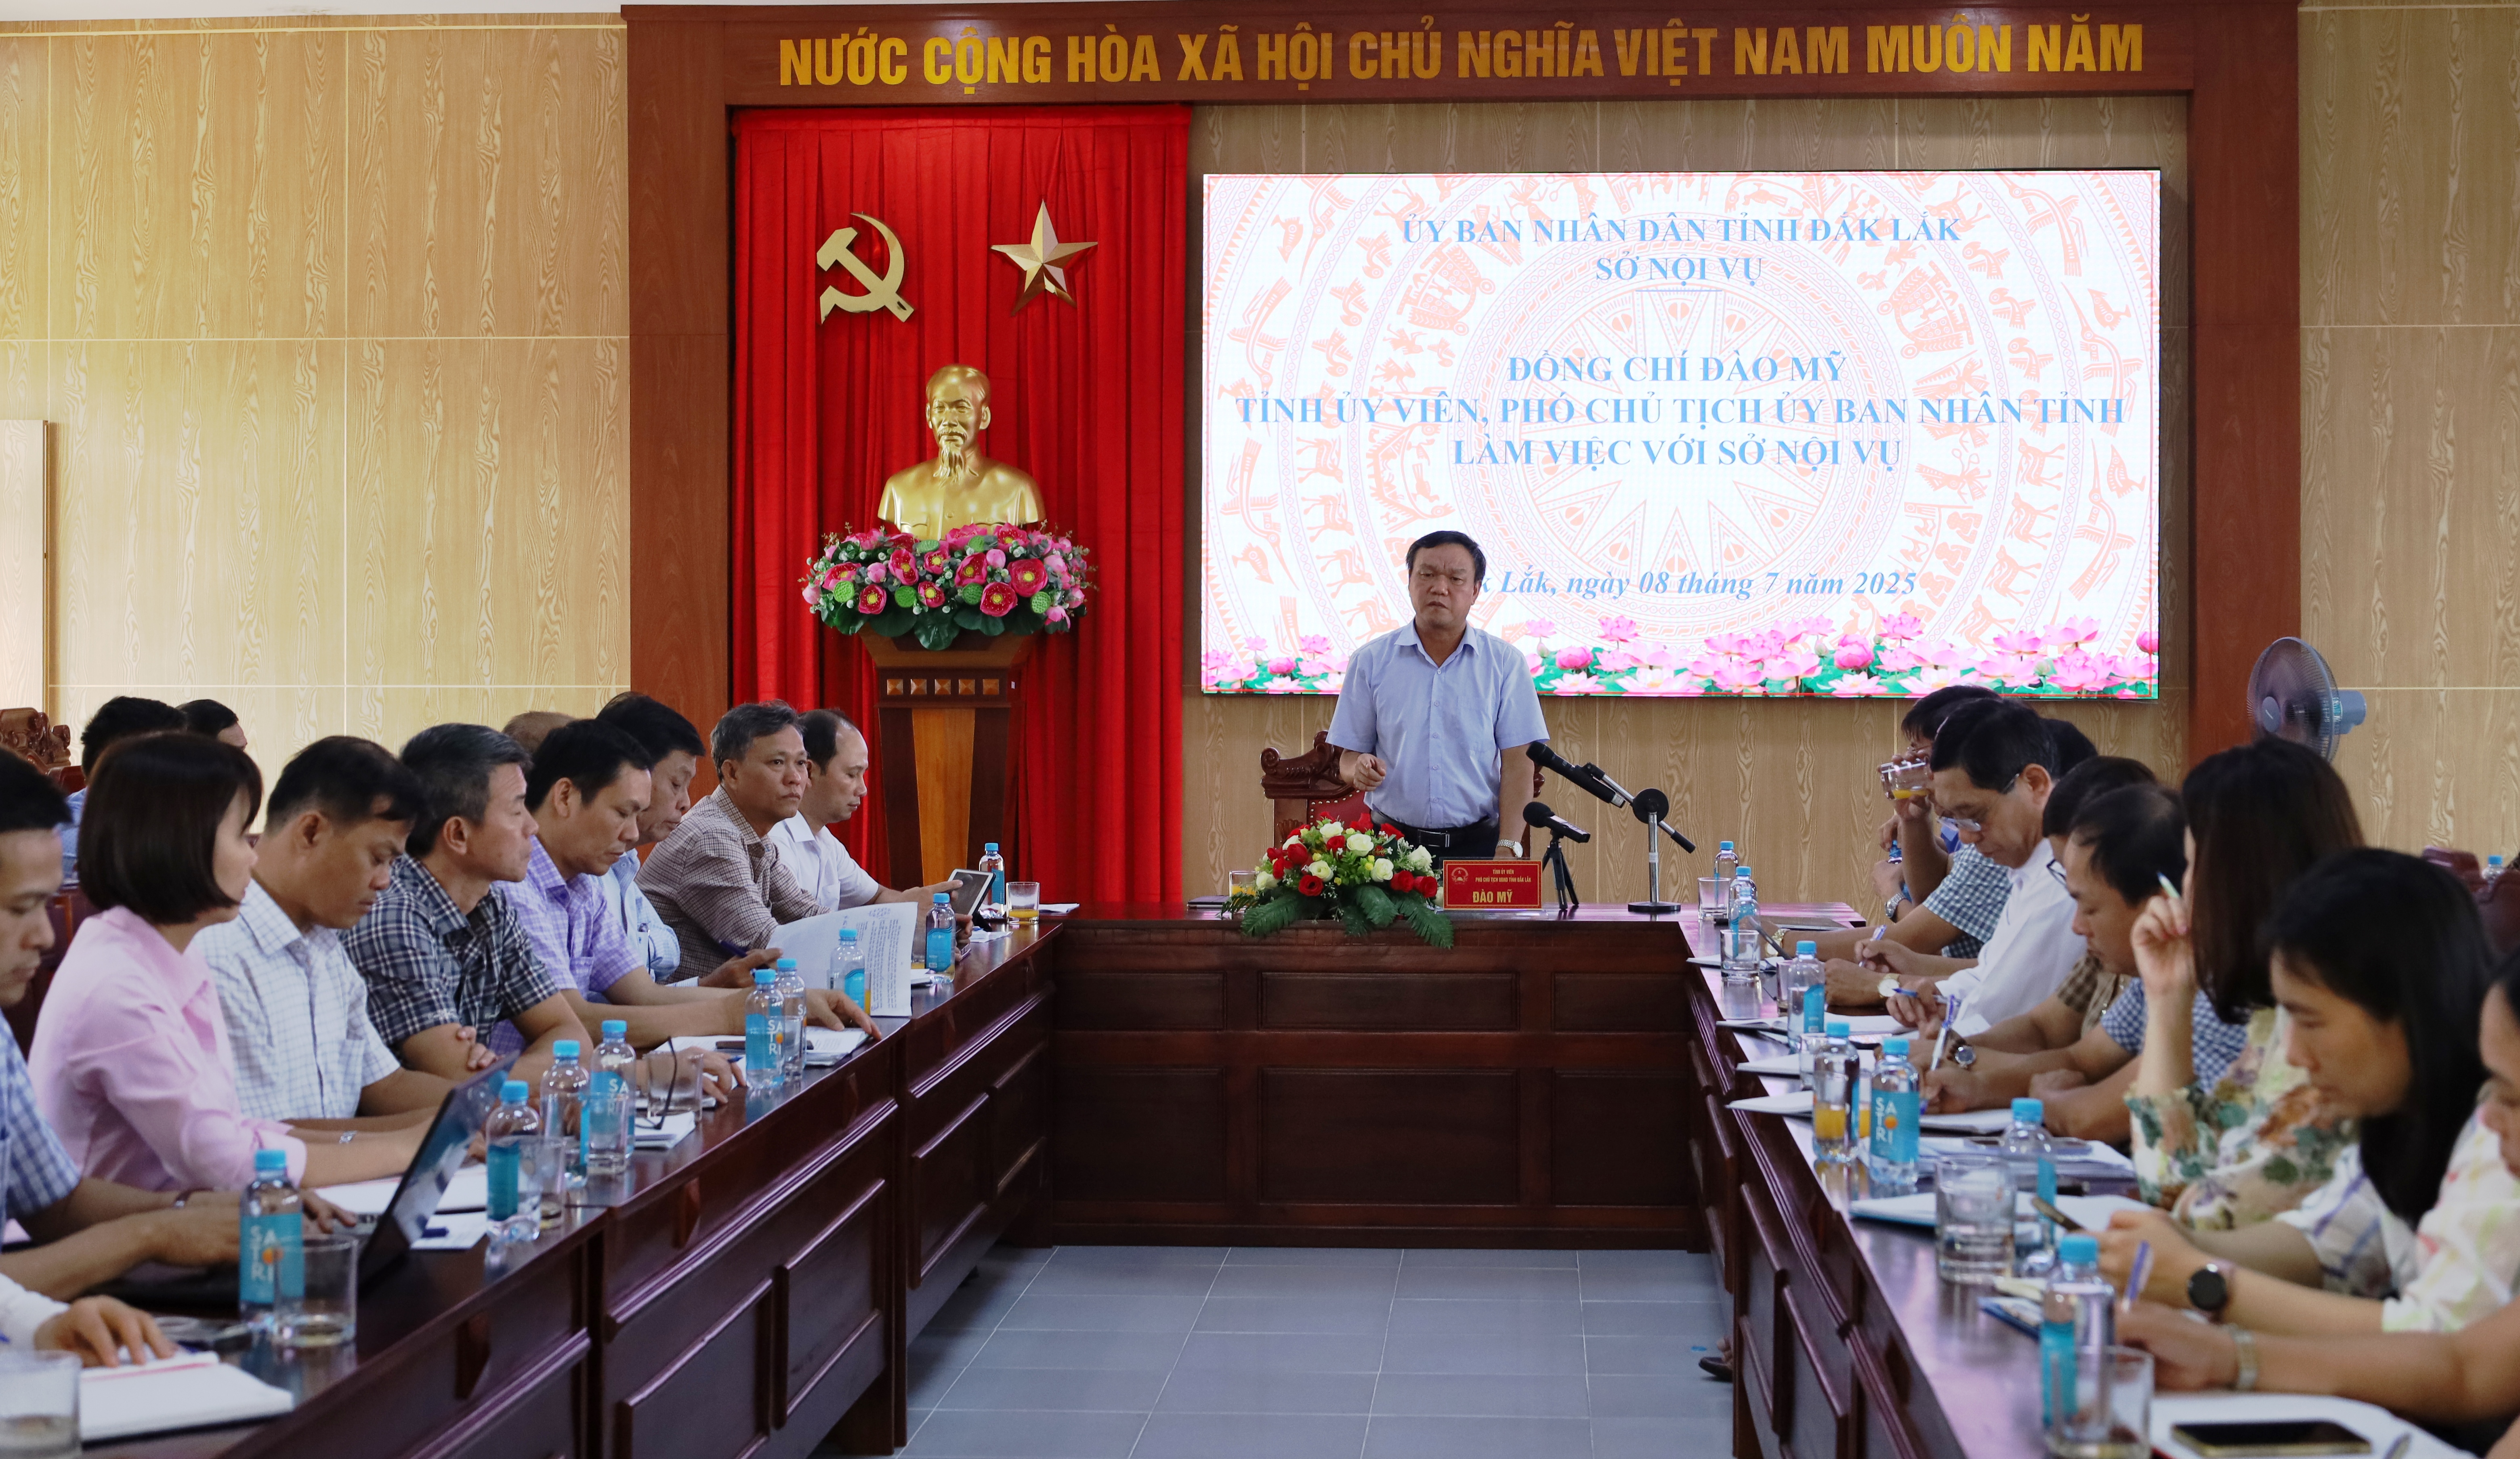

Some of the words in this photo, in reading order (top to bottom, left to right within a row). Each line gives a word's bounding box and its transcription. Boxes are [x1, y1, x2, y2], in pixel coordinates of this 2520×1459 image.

[780, 27, 908, 85] NƯỚC
[923, 27, 1051, 94] CỘNG
[1068, 25, 1161, 82] HÒA
[1178, 25, 1243, 80] XÃ
[1258, 23, 1331, 90] HỘI
[1349, 15, 1441, 79] CHỦ
[1459, 22, 1603, 77] NGHĨA
[1615, 18, 1717, 85] VIỆT
[1735, 27, 1848, 74] NAM
[1867, 15, 2011, 73] MUÔN
[2027, 15, 2142, 72] NĂM
[1402, 213, 1446, 242] ỦY
[1458, 220, 1522, 242] BAN
[1535, 212, 1626, 241] NHÂN
[1640, 212, 1705, 241] DÂN
[1717, 213, 1797, 241] TỈNH
[1811, 212, 1880, 241] ĐẮK
[1893, 212, 1960, 240] LẮK
[1596, 252, 1639, 279] SỞ
[1650, 254, 1706, 286] NỘI
[1719, 258, 1762, 286] VỤ
[1510, 350, 1611, 381] ĐỒNG
[1624, 350, 1687, 381] CHÍ
[1700, 350, 1778, 381] ĐÀO
[1791, 351, 1846, 381] MỸ
[1237, 392, 1321, 422] TỈNH
[1337, 392, 1383, 422] ỦY
[1394, 391, 1488, 428] VIÊN,
[1502, 392, 1574, 422] PHÓ
[1586, 392, 1661, 423] CHỦ
[1674, 399, 1761, 430] TỊCH
[1777, 392, 1823, 423] ỦY
[1836, 399, 1907, 423] BAN
[1920, 391, 2022, 423] NHÂN
[2035, 392, 2123, 423] TỈNH
[1455, 433, 1531, 464] LÀM
[1545, 437, 1630, 471] VIỆC
[1643, 434, 1705, 464] VỚI
[1719, 433, 1766, 464] SỞ
[1777, 437, 1839, 471] NỘI
[1853, 441, 1900, 471] VỤ
[1501, 565, 1556, 594] Lắk,
[1567, 571, 1630, 599] ngày
[1640, 572, 1669, 593] 08
[1679, 572, 1753, 599] tháng
[1765, 572, 1779, 593] 7
[1787, 574, 1843, 594] năm
[1854, 572, 1916, 594] 2025
[1472, 889, 1493, 903] ĐÀO
[1497, 889, 1513, 903] MỸ
